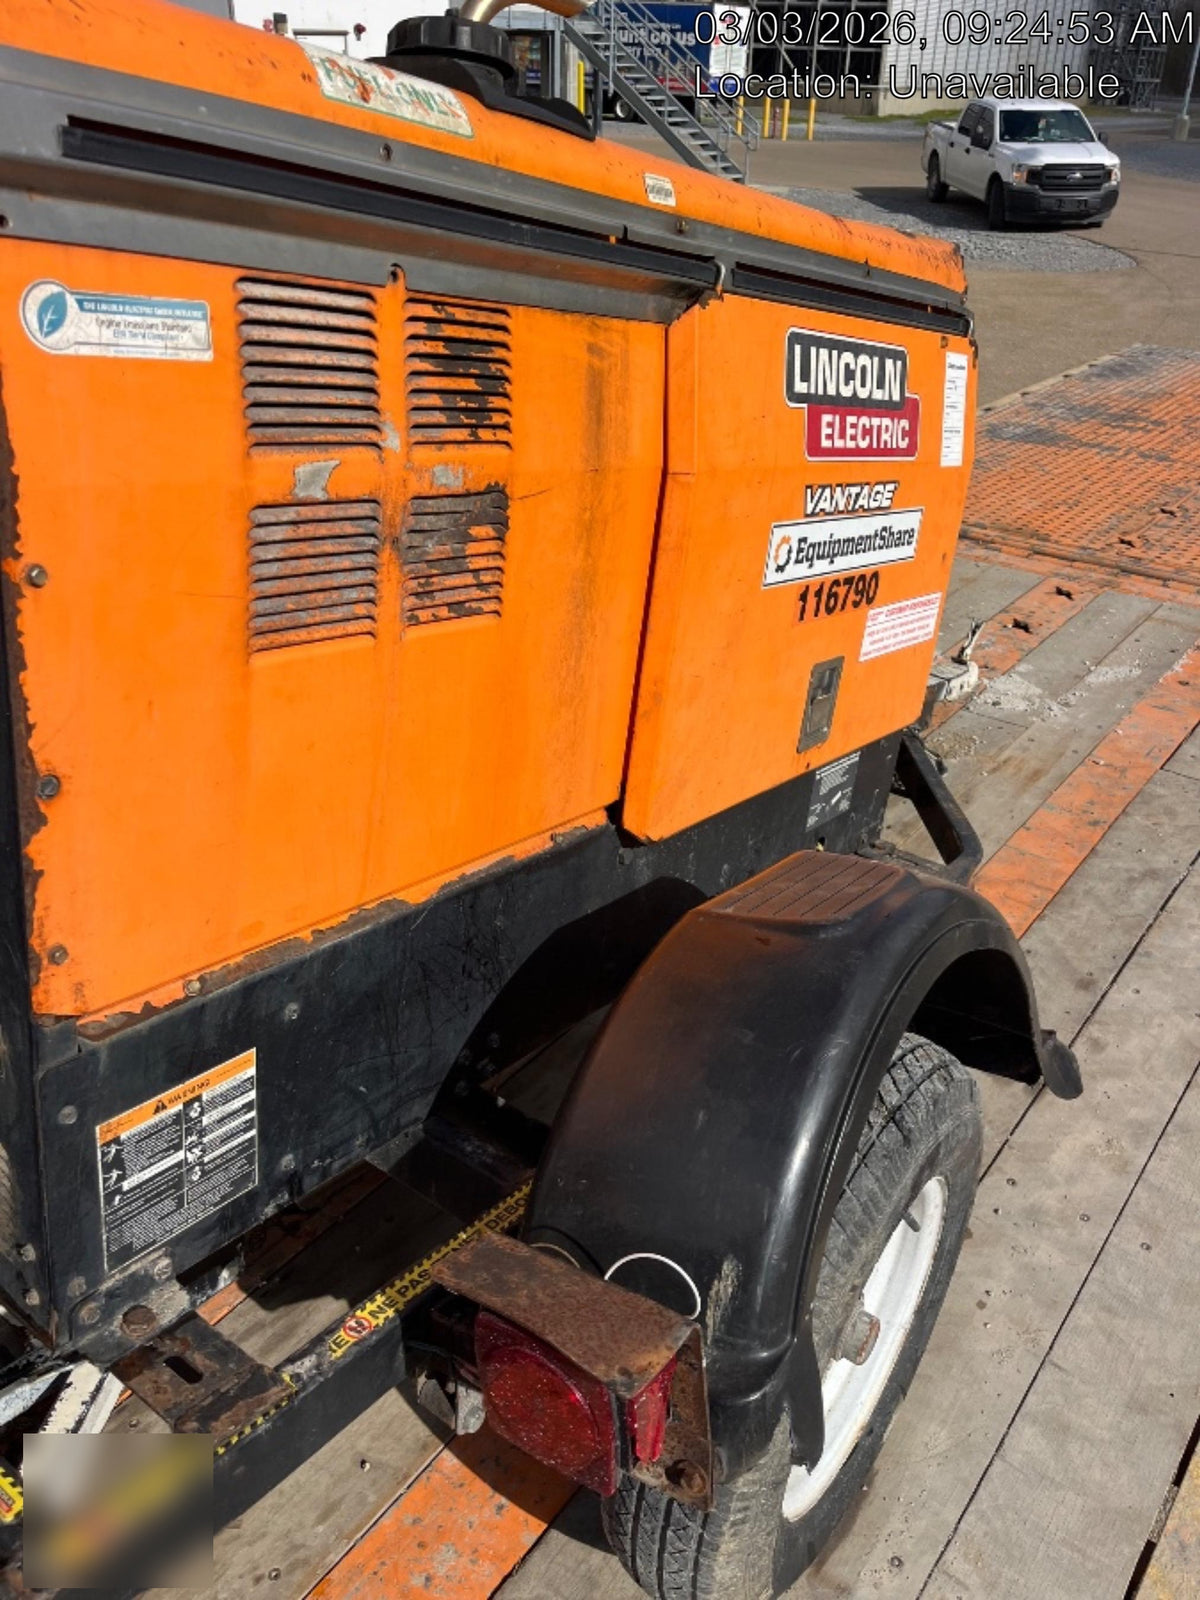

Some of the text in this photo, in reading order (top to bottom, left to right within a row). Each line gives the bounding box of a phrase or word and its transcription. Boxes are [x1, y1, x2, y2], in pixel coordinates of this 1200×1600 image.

[792, 343, 903, 402] LINCOLN
[820, 413, 910, 449] ELECTRIC
[804, 482, 898, 517] VANTAGE
[794, 526, 916, 569] EquipmentShare
[797, 571, 880, 623] 116790
[484, 1197, 528, 1230] DEBO
[395, 1268, 432, 1300] PAS
